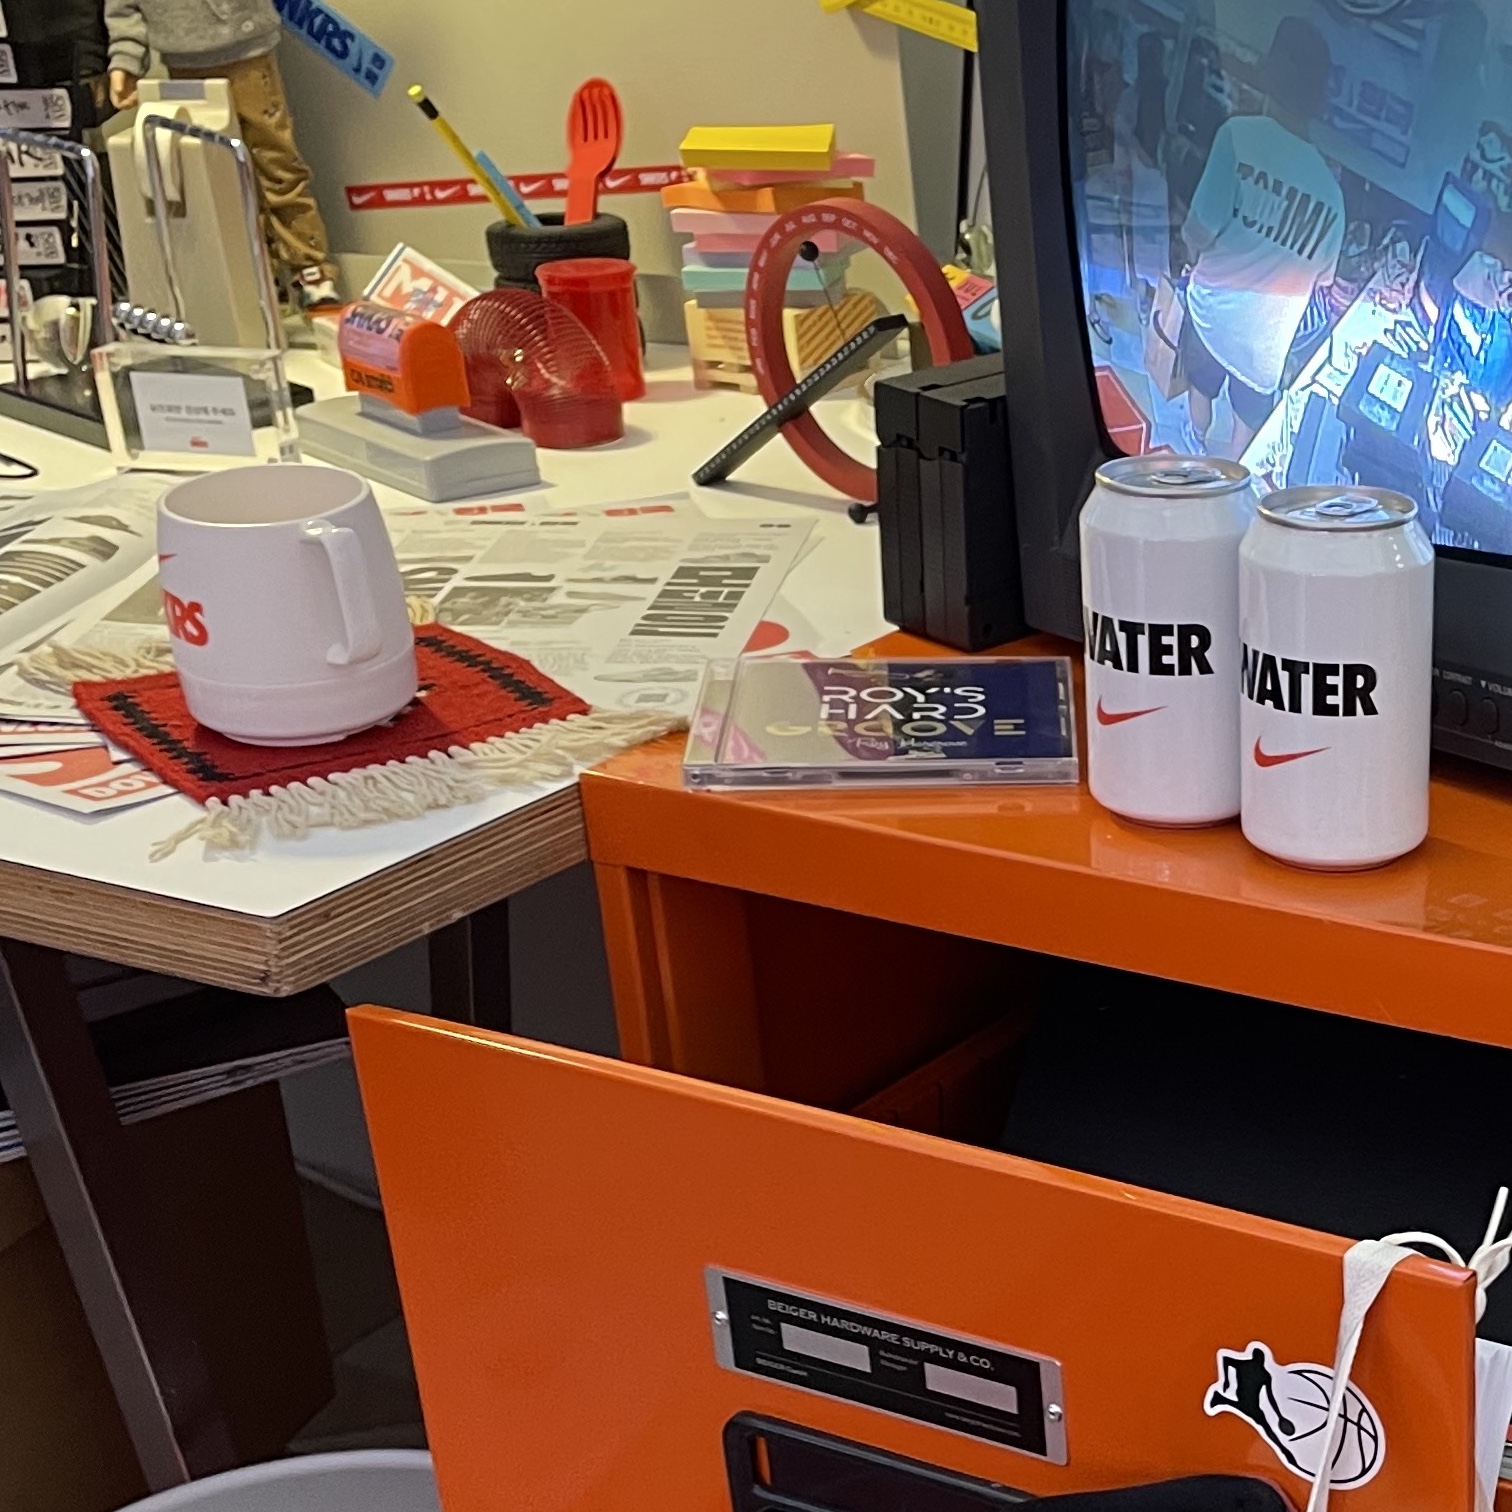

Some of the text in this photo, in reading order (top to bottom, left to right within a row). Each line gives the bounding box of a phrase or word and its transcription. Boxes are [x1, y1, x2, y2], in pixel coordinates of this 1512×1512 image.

[164, 590, 209, 647] RS
[822, 686, 985, 703] ROY'S
[819, 703, 987, 720] HARD
[765, 718, 1027, 738] GROOVE
[767, 1299, 818, 1323] BEIGER
[820, 1314, 901, 1346] HARDWARE
[902, 1336, 955, 1360] SUPPLY
